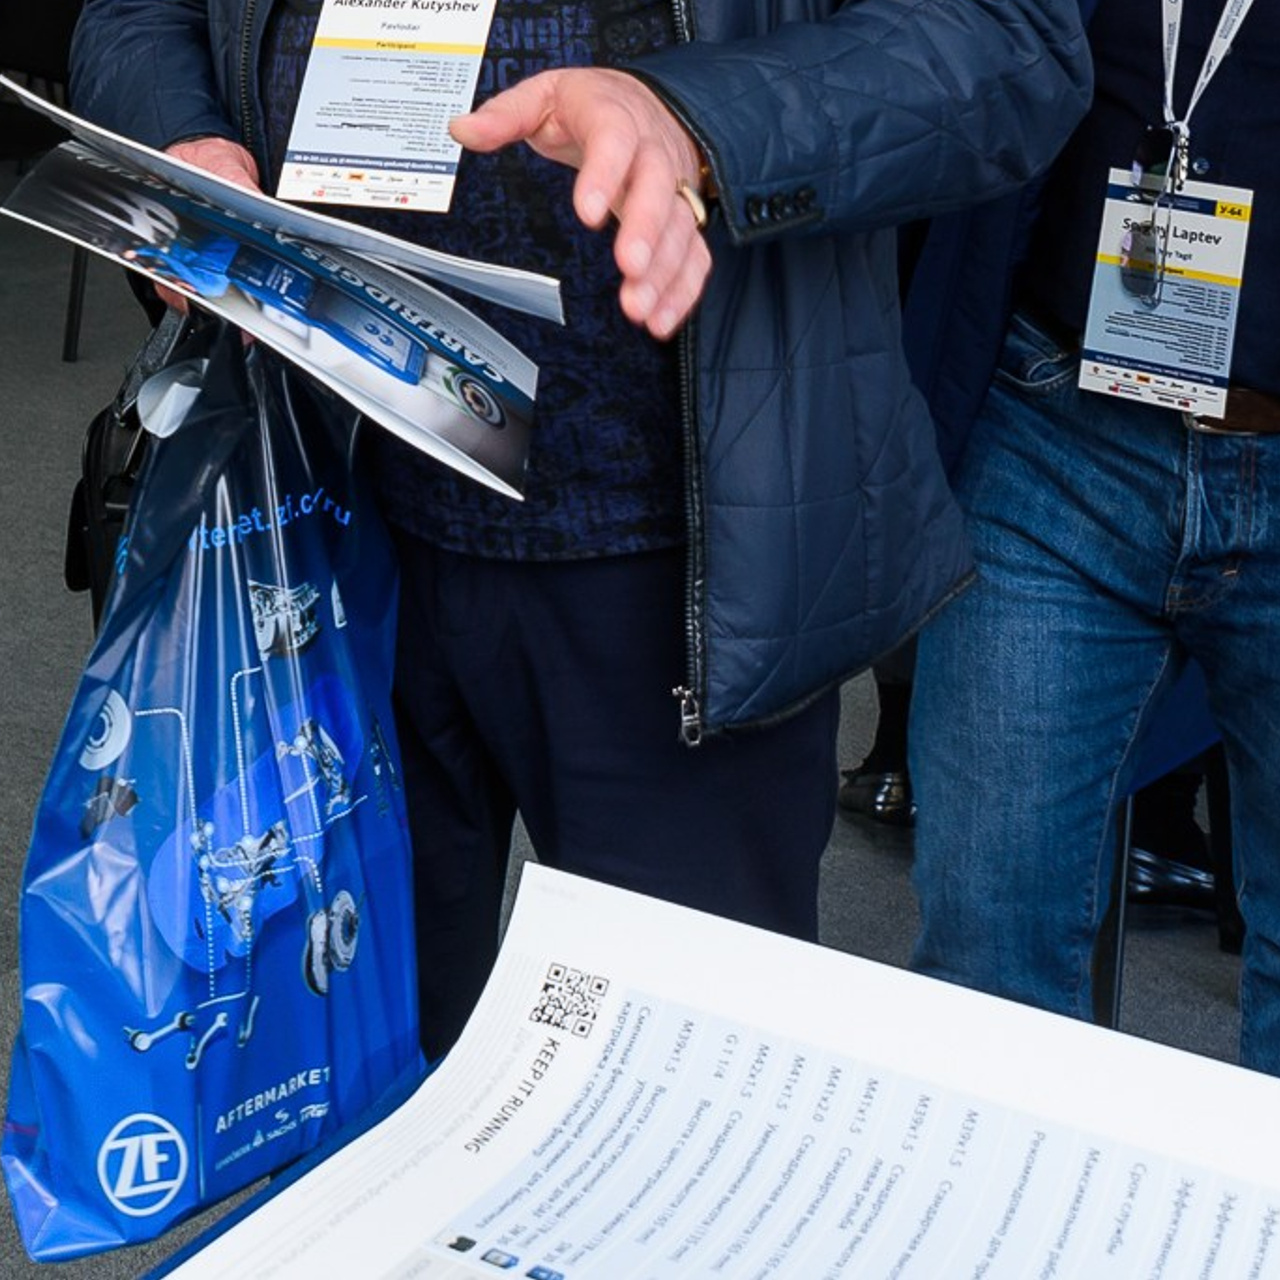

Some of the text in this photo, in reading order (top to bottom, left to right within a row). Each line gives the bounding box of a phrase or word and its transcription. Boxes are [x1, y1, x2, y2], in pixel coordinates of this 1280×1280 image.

[1172, 224, 1223, 247] Laptev
[300, 247, 505, 383] CARTRIDGES
[592, 999, 636, 1072] картриджа
[616, 1004, 653, 1068] Сменный
[661, 1017, 695, 1075] M39x1.5
[462, 1035, 561, 1157] KEEP IT RUNNING
[635, 1082, 666, 1126] Высота
[738, 1042, 771, 1100] M42x1.5
[773, 1053, 806, 1112] M41x1.5
[810, 1065, 842, 1123] M41x2.0
[847, 1076, 881, 1136] M41x1.5
[680, 1097, 711, 1141] Высота
[694, 1108, 743, 1178] Стандартная
[899, 1093, 932, 1153] M39x1.5
[947, 1108, 979, 1169] M39x1.5
[727, 1119, 779, 1195] Уменьшенная
[768, 1132, 816, 1203] Стандартная
[805, 1145, 852, 1216] Стандартная
[994, 1129, 1046, 1237] Рекомендовано
[856, 1161, 905, 1235] Стандартная
[907, 1178, 953, 1253] Стандартная
[1053, 1147, 1102, 1251] Максимальное
[1103, 1161, 1148, 1257] Срок службы
